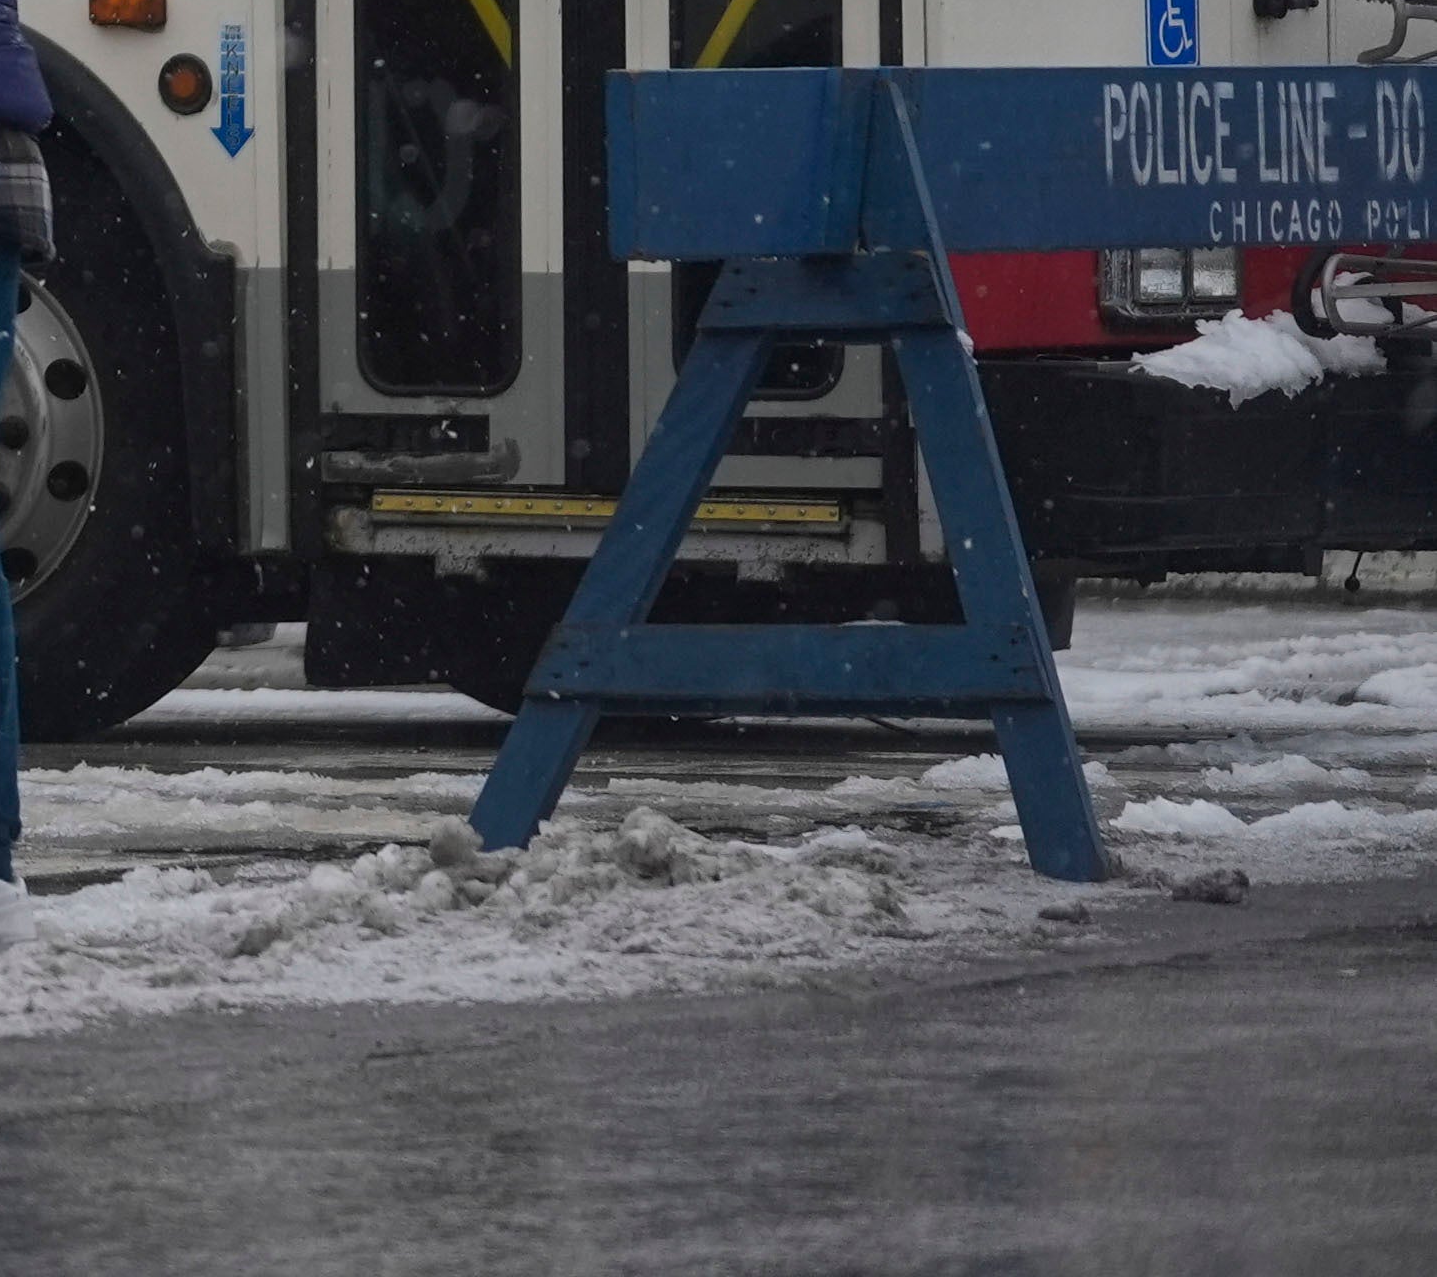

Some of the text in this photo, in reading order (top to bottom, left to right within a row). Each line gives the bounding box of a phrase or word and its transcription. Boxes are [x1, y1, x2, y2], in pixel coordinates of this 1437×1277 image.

[1103, 80, 1238, 187] POLICE
[1255, 80, 1339, 185] LINE
[1376, 78, 1426, 184] DO
[1208, 199, 1343, 243] CHICAGO
